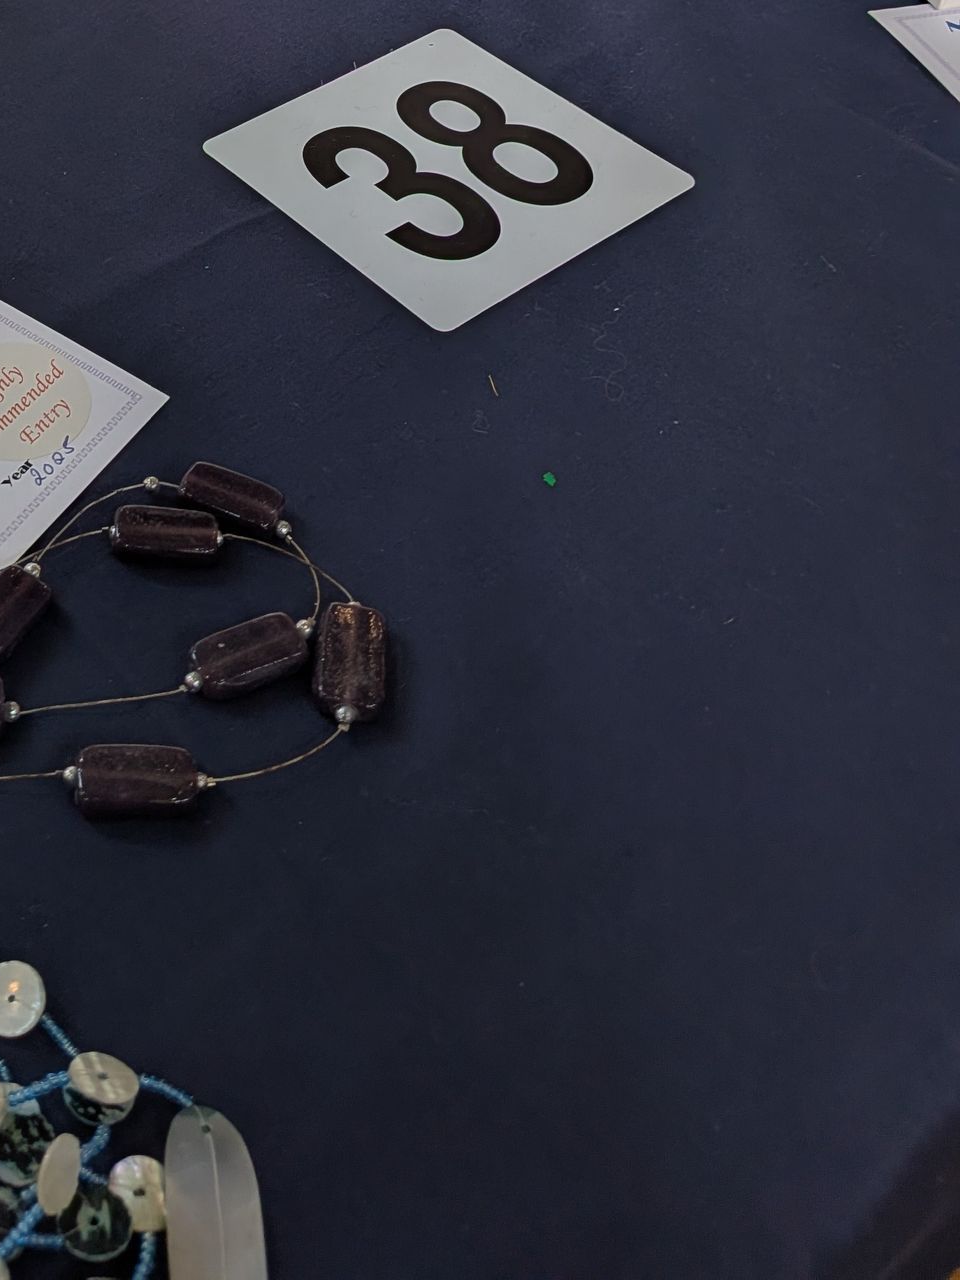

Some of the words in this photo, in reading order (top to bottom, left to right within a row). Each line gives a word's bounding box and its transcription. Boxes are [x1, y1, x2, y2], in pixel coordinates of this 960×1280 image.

[302, 80, 594, 261] 38
[19, 399, 71, 445] Entry
[0, 458, 33, 487] Year
[30, 435, 74, 486] 2025
